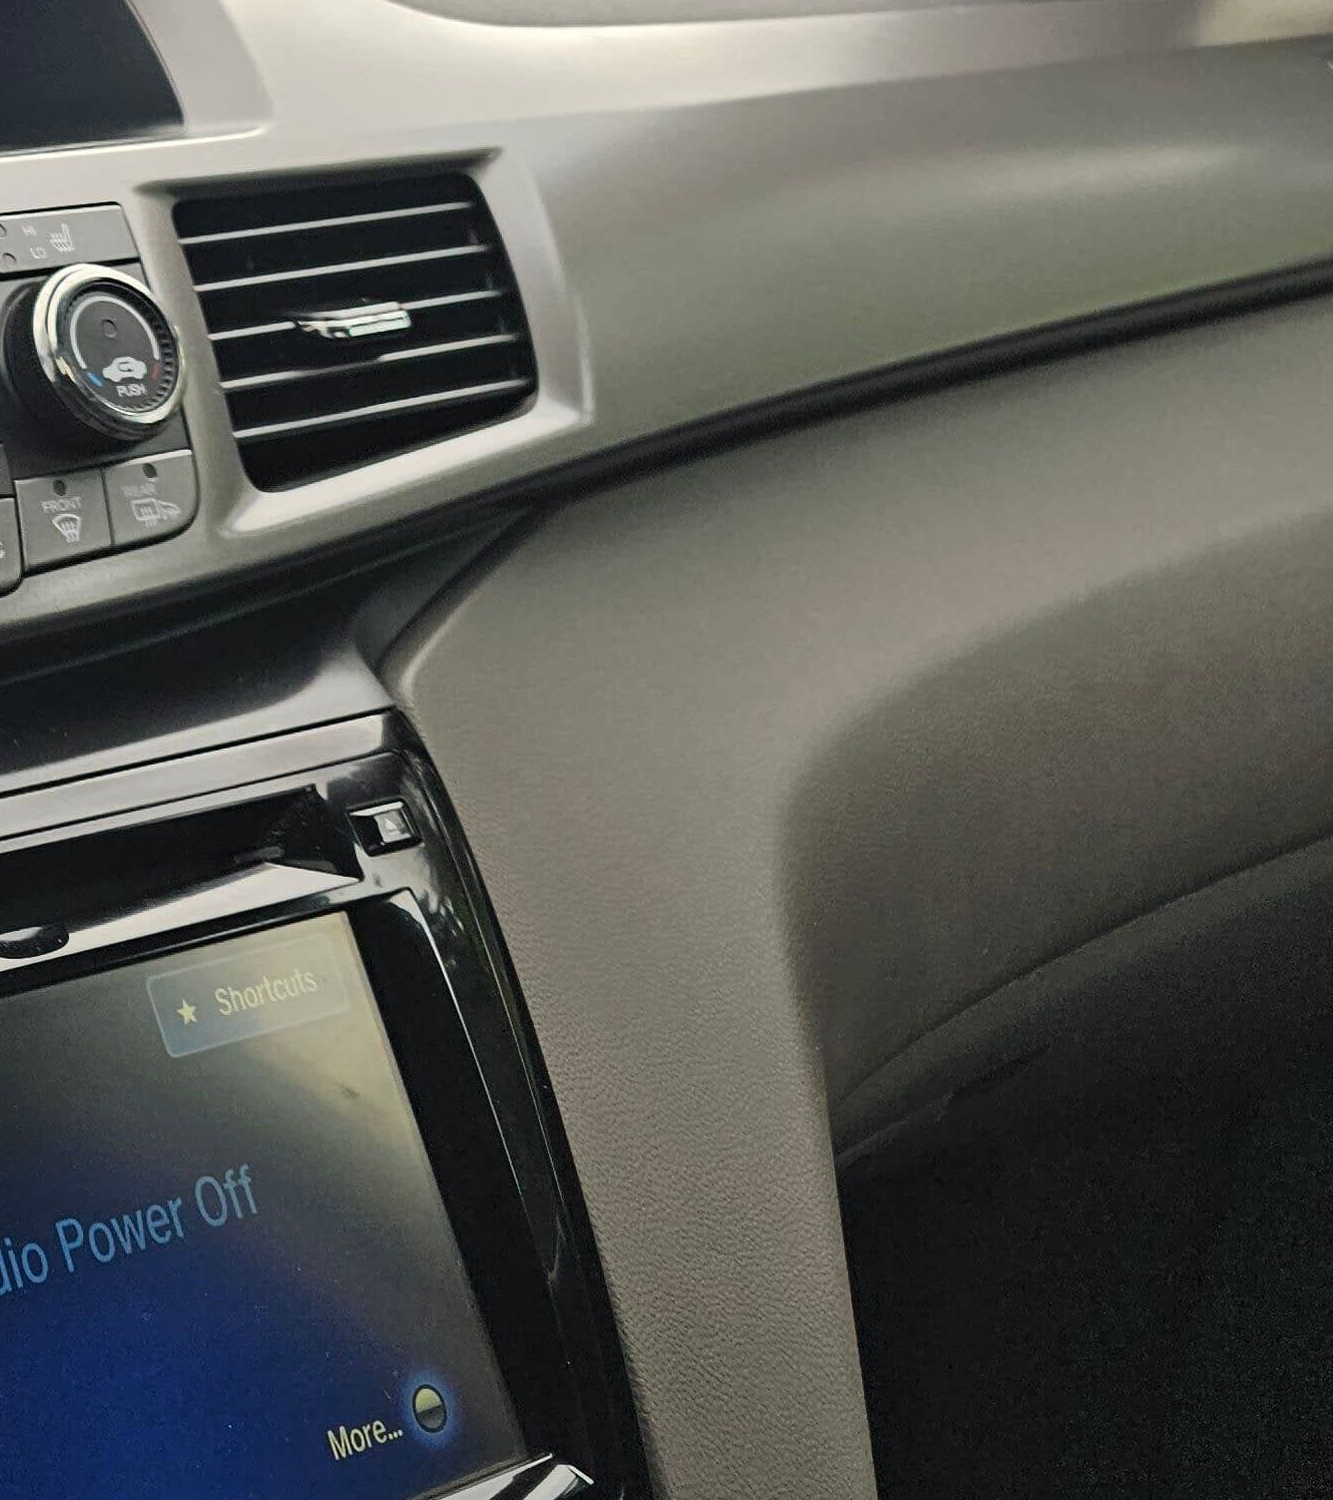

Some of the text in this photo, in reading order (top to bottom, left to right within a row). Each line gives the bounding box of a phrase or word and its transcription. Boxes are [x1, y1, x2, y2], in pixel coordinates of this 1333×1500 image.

[115, 383, 149, 398] PUSH
[41, 496, 83, 514] FRONT
[213, 968, 318, 1017] Shortcuts
[54, 1197, 185, 1273] Power
[194, 1163, 259, 1228] Off
[326, 1419, 404, 1461] More...
